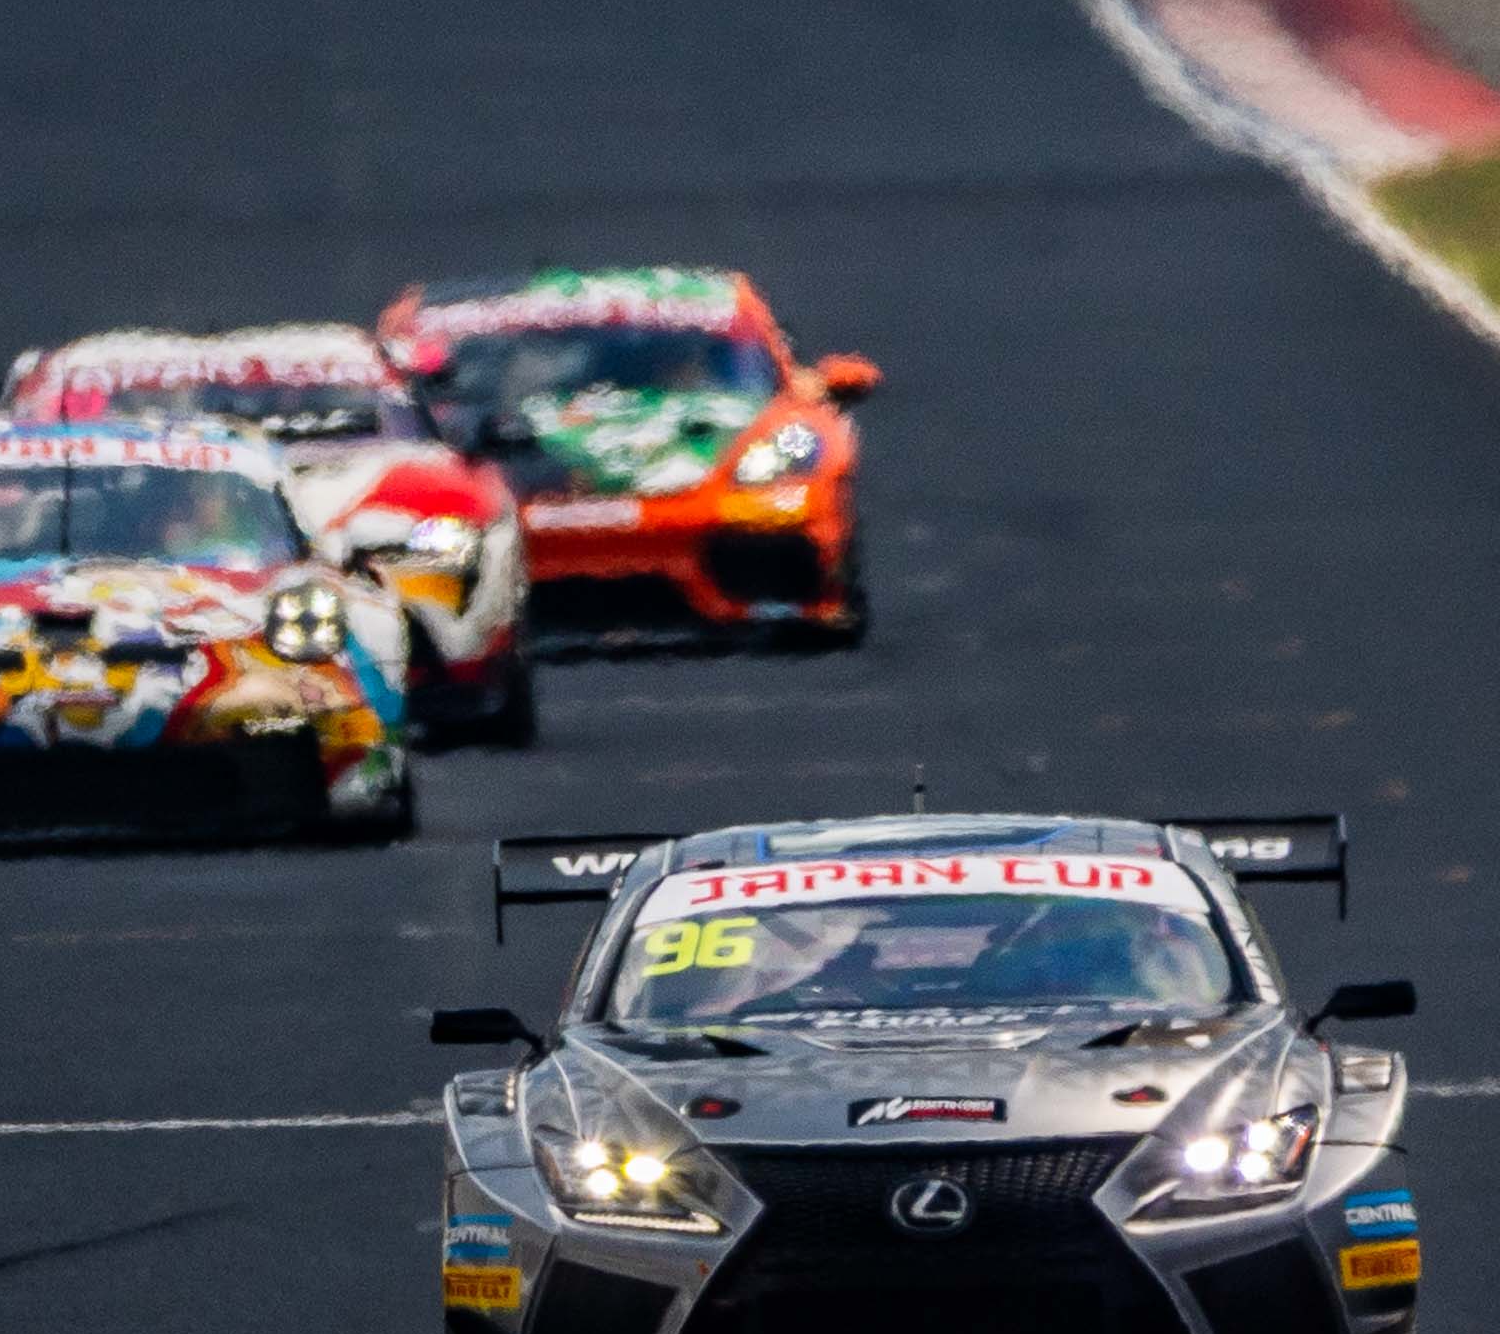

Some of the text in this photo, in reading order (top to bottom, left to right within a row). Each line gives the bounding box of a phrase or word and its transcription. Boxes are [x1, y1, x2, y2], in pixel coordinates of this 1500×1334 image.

[690, 858, 1154, 906] JAPAN CUP
[641, 916, 759, 979] 96
